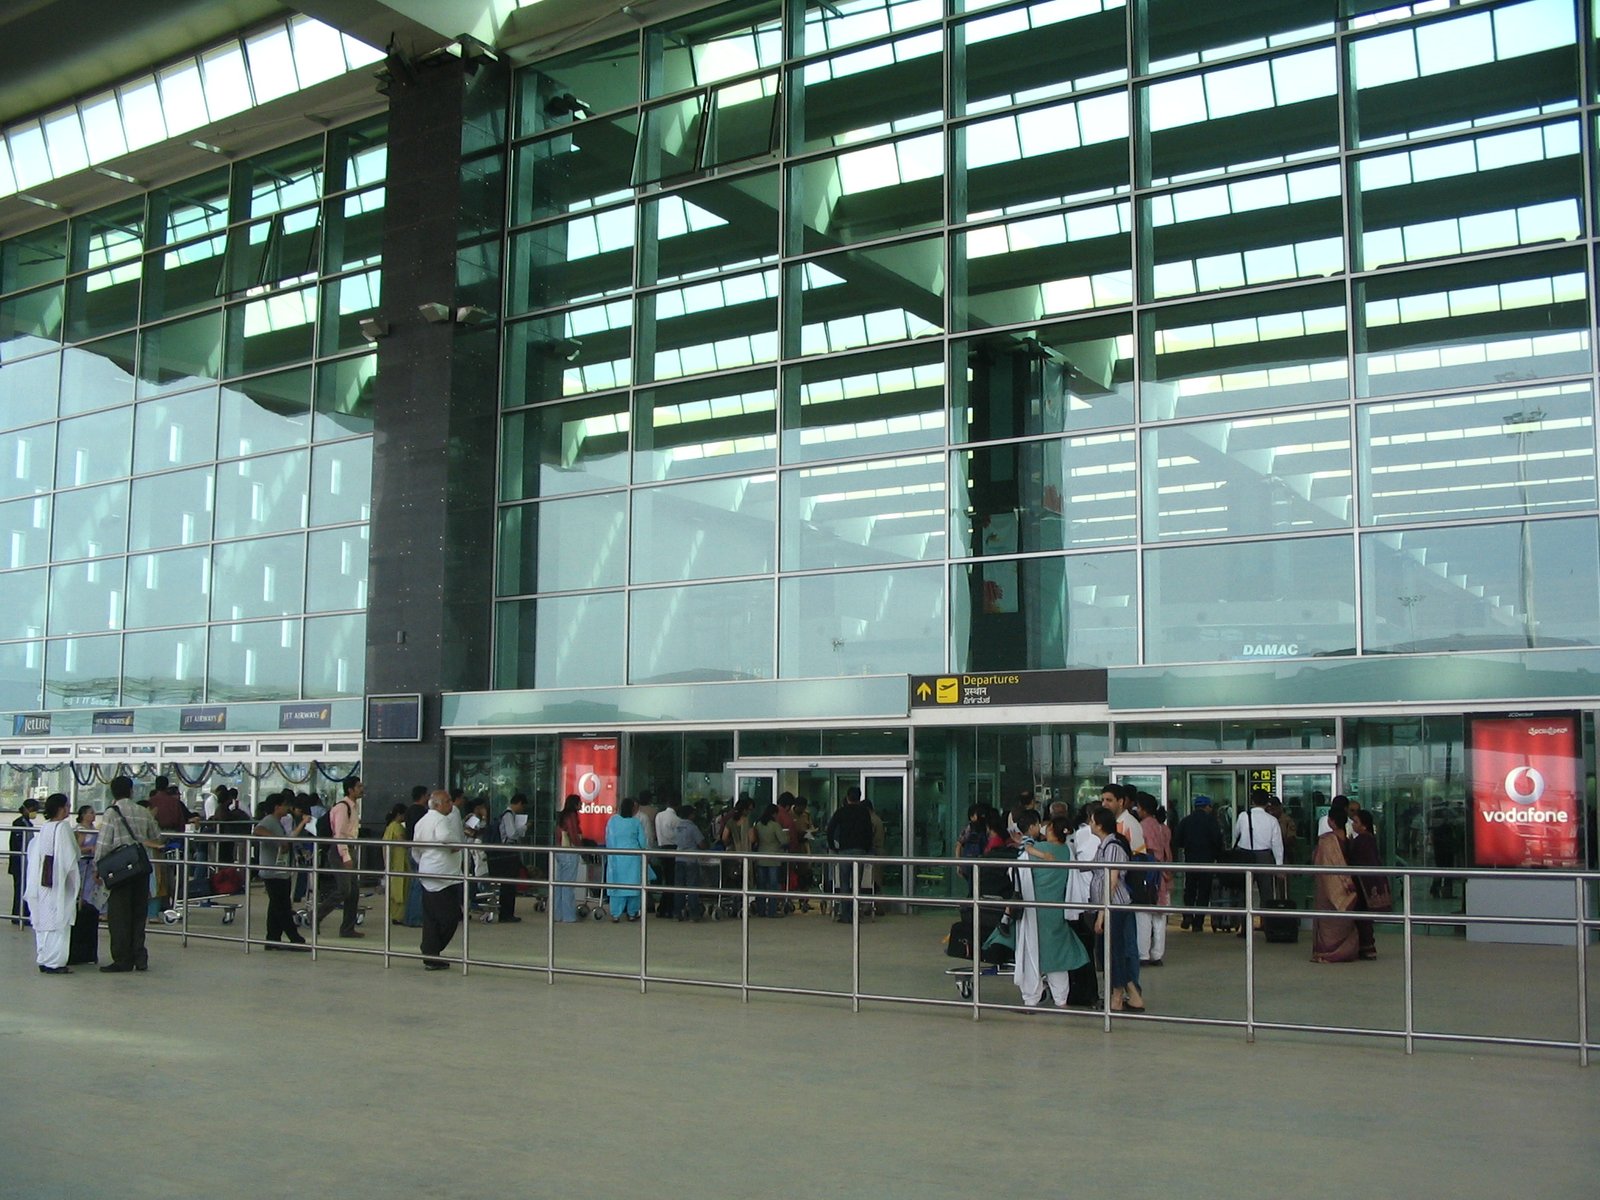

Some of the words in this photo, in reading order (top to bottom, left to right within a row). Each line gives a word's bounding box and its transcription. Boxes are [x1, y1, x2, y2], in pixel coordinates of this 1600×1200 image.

[1242, 643, 1299, 656] DAMAC
[962, 674, 1020, 687] Departures
[963, 687, 987, 696] प्रस्थान
[184, 715, 193, 725] JET
[194, 714, 217, 723] AIRWAYS
[282, 712, 293, 723] JET
[294, 711, 320, 721] AIRWAYS
[24, 715, 50, 733] JetLite
[1483, 807, 1568, 823] vodafone
